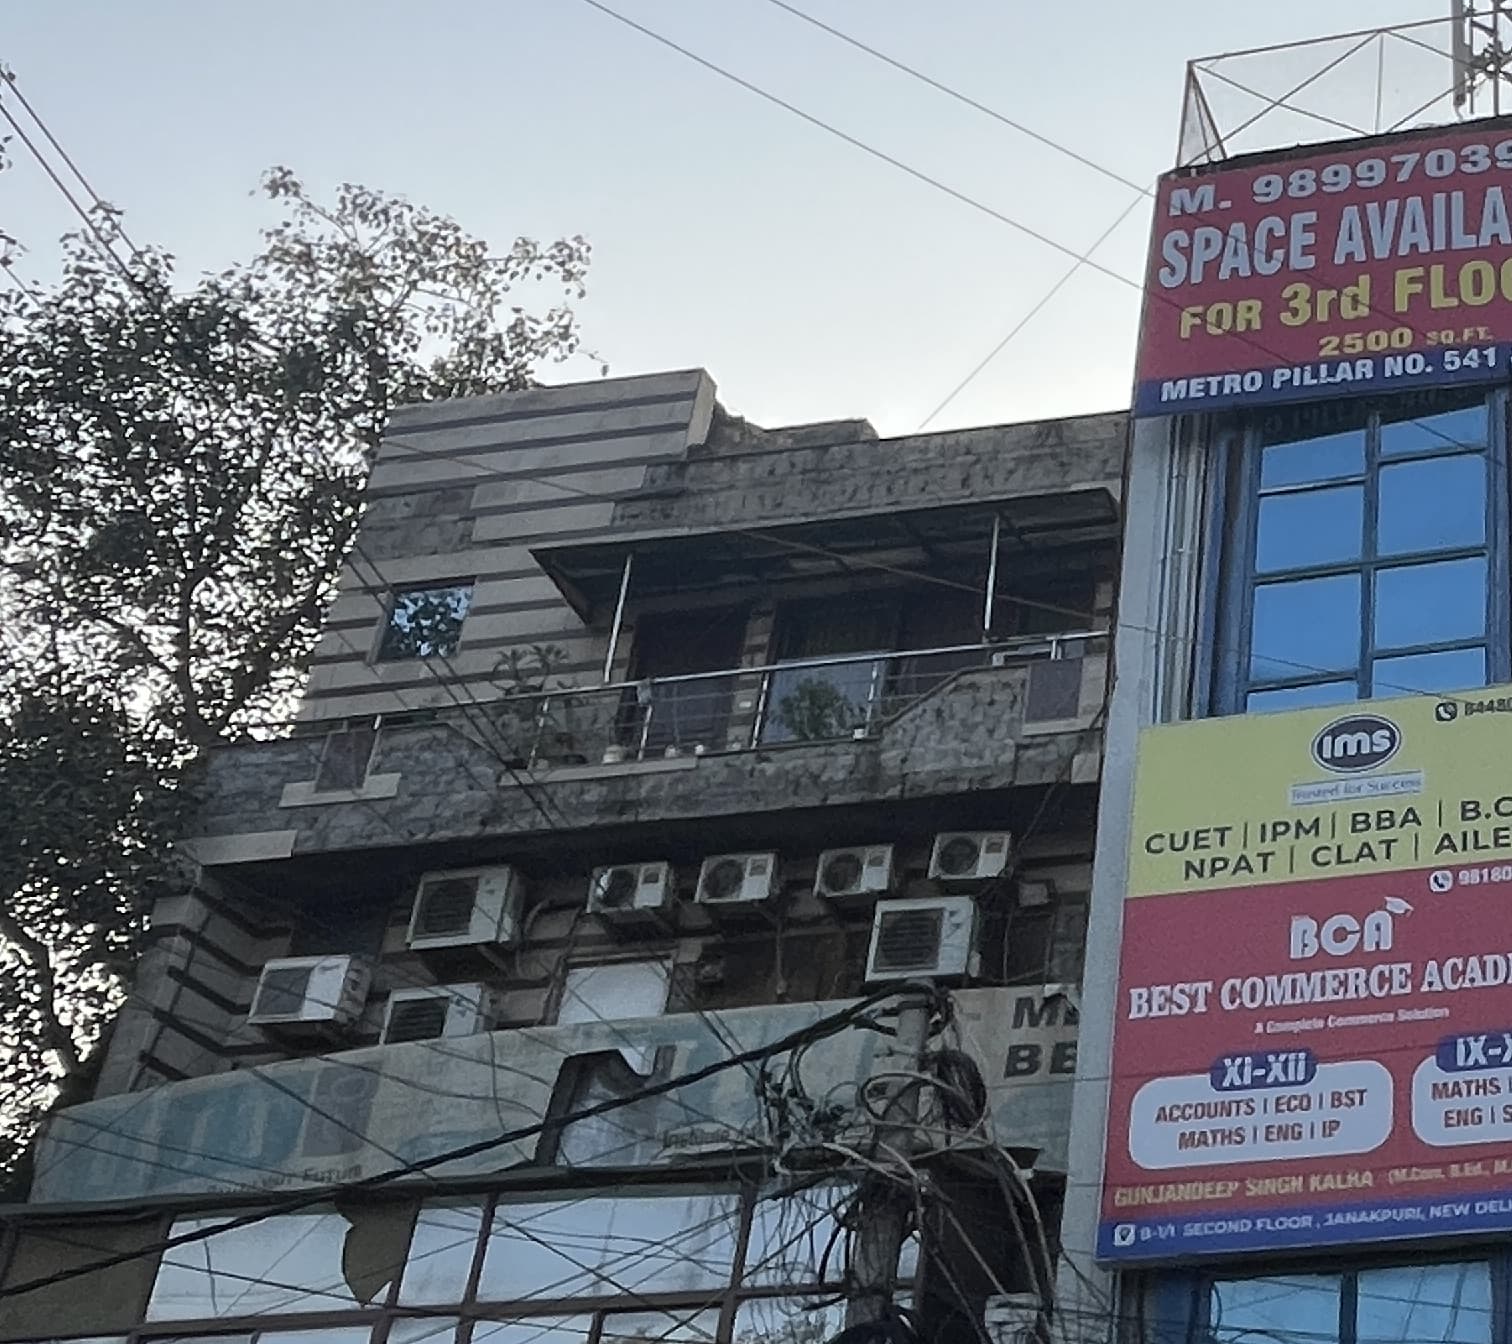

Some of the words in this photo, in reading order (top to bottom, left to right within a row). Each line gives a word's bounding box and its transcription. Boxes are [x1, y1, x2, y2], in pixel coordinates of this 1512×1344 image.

[1169, 188, 1231, 216] M.
[1159, 211, 1318, 288] SPACE
[1179, 300, 1262, 339] FOR
[1280, 275, 1371, 327] 3rd
[1319, 328, 1412, 356] 2500
[1161, 370, 1262, 402] METRO
[1273, 361, 1373, 389] PILLAR
[1385, 353, 1432, 377] NO.
[1444, 348, 1496, 371] 541
[1145, 826, 1232, 855] CUET
[1260, 817, 1320, 844] IPM
[1350, 806, 1422, 834] BBA
[1183, 852, 1273, 881] NPAT
[1310, 839, 1397, 867] CLAT
[1290, 910, 1393, 959] BCA
[1129, 982, 1212, 1019] BEST
[1220, 961, 1413, 1010] COMMERCE
[1155, 1098, 1255, 1123] ACCOUNTS
[1274, 1094, 1312, 1115] ECO
[1330, 1088, 1367, 1109] BST
[1431, 1079, 1501, 1101] MATHS
[1178, 1127, 1245, 1150] MATHS
[1264, 1122, 1302, 1142] ENG
[1321, 1120, 1341, 1139] IP
[1444, 1108, 1482, 1128] ENG
[1245, 1176, 1303, 1196] SINGH
[1183, 1220, 1251, 1237] SECOND
[1430, 1204, 1471, 1218] NEW
